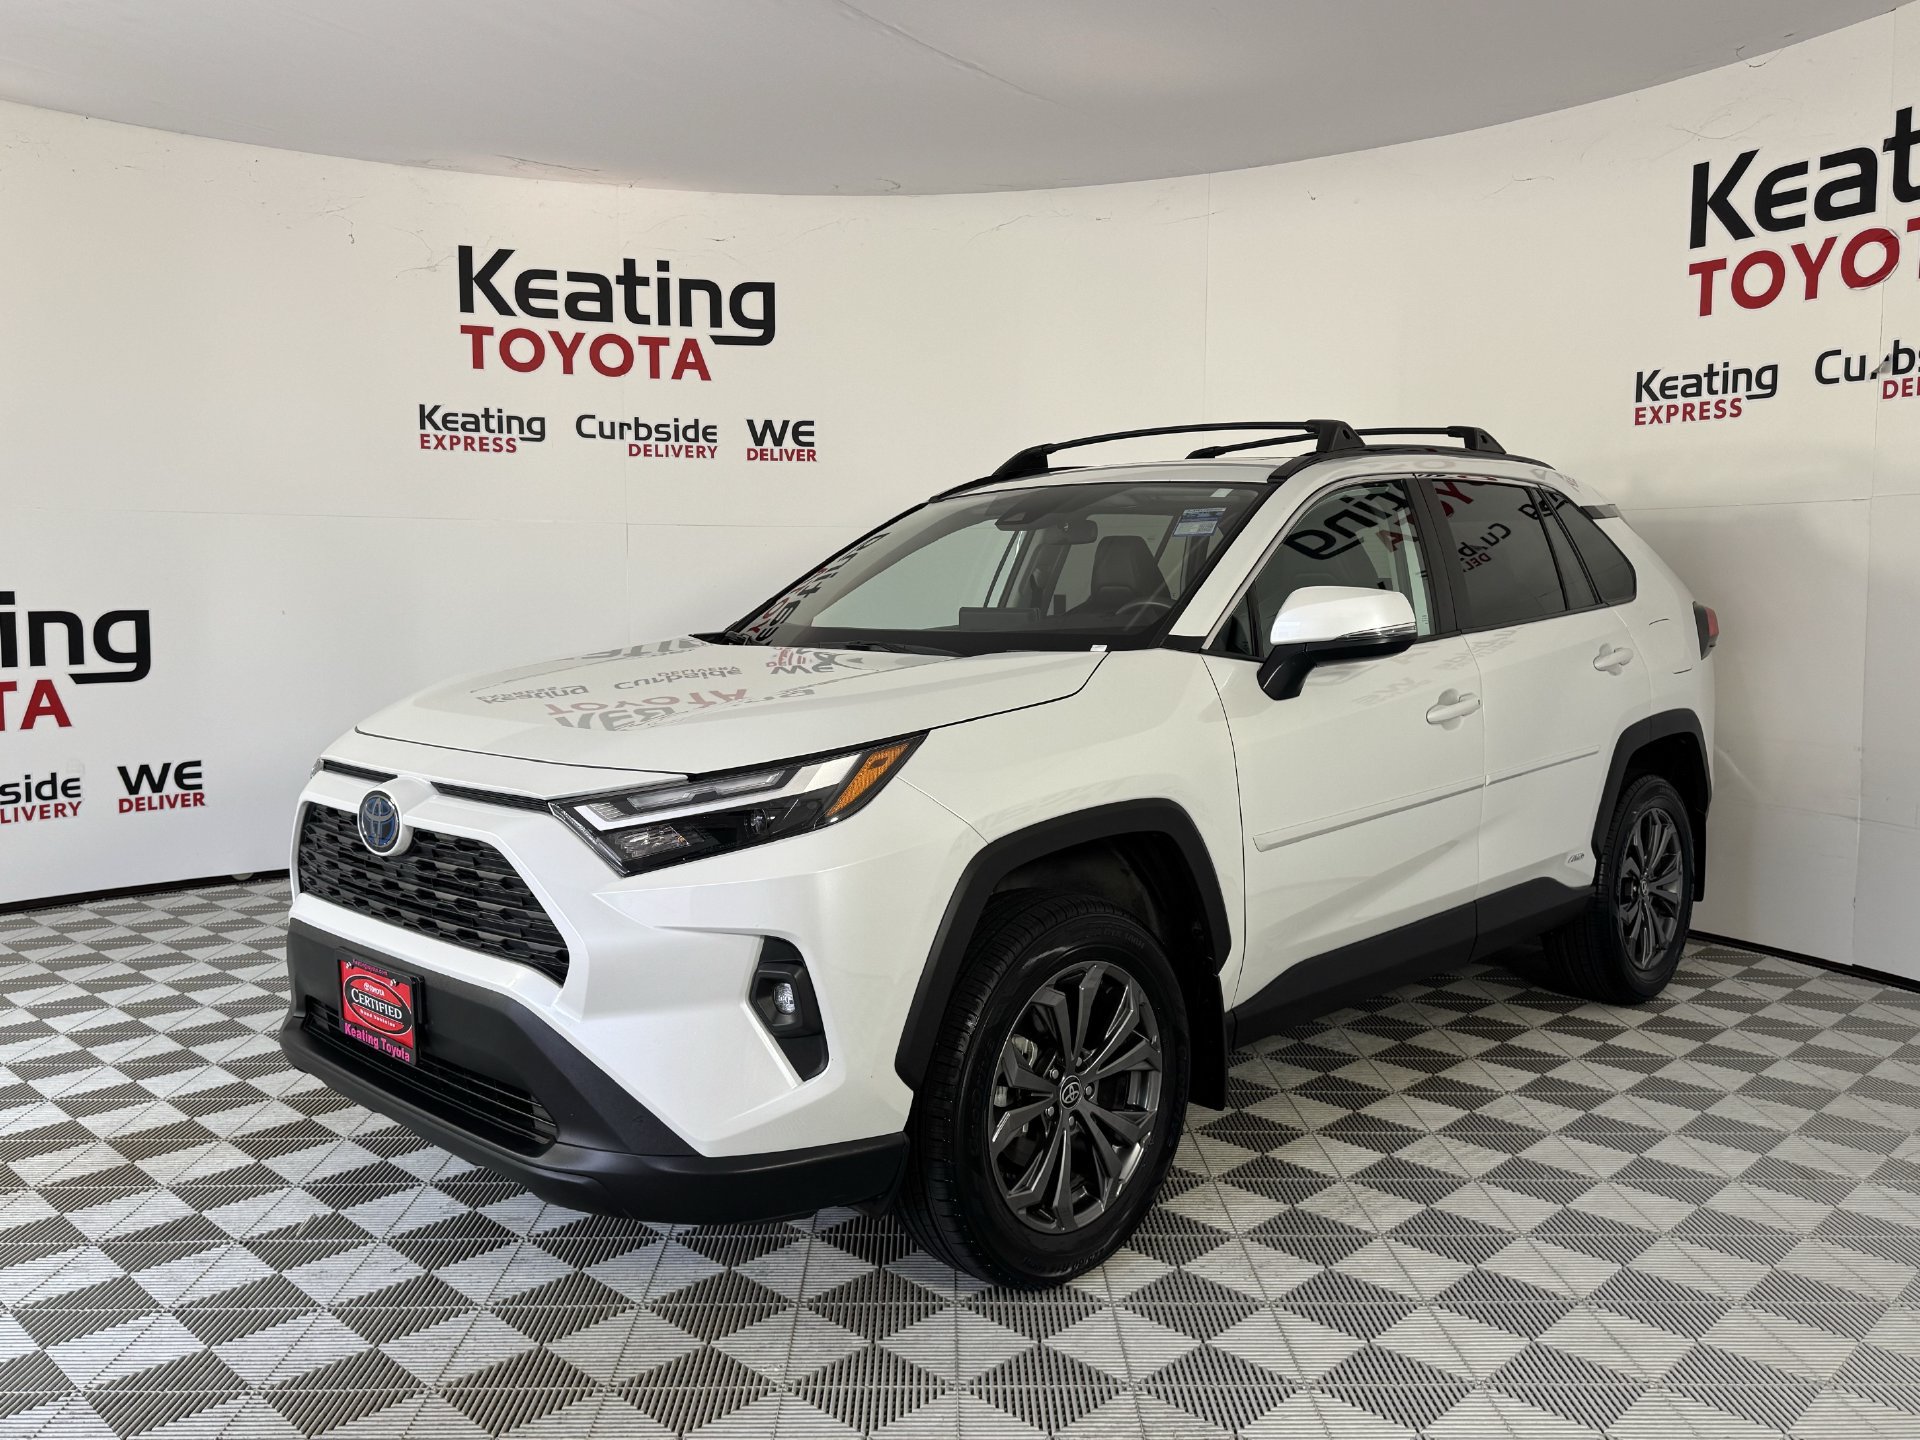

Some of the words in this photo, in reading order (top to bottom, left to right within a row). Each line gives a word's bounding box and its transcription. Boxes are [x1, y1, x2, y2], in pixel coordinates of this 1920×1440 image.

[458, 245, 776, 346] Keating
[460, 325, 712, 381] TOYOTA
[1814, 339, 1920, 385] Cub
[1635, 361, 1778, 403] Keating
[1882, 376, 1920, 400] DE
[419, 404, 546, 442] Keating
[575, 414, 718, 443] Curbside
[746, 419, 815, 448] WE
[1634, 397, 1743, 426] EXPRESS
[420, 434, 518, 454] EXPRESS
[628, 443, 718, 459] DELIVERY
[746, 448, 817, 462] DELIVER
[117, 760, 203, 795] WE
[118, 792, 206, 813] DELIVER
[351, 987, 403, 1020] CERTIFIED
[344, 1022, 380, 1051] Keating
[380, 1037, 410, 1063] Toyota
